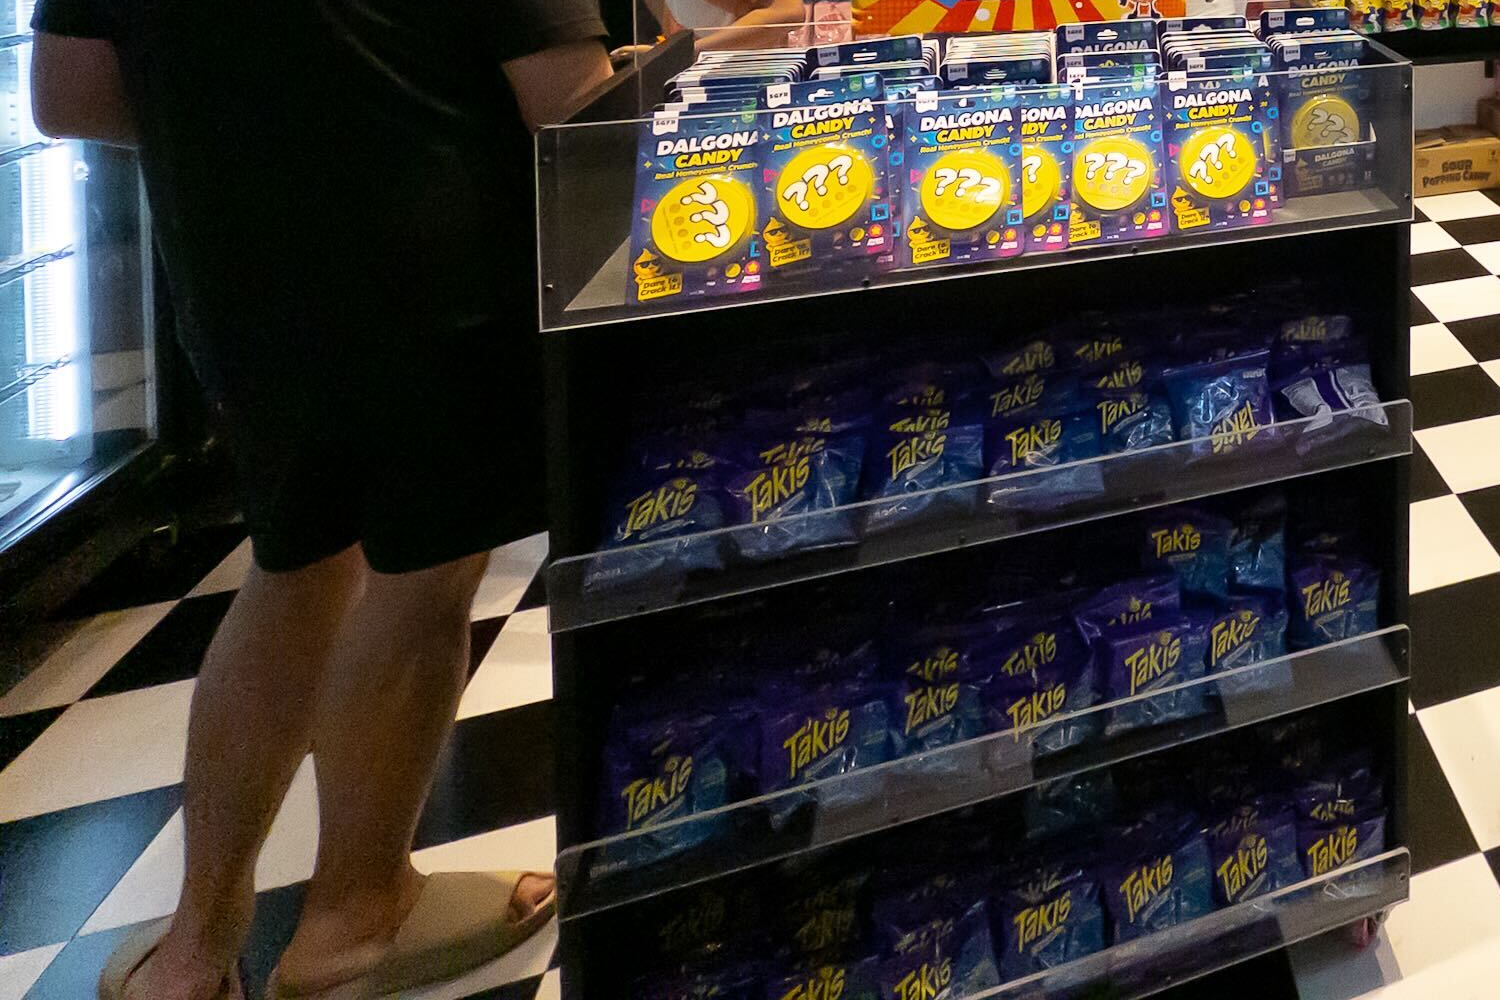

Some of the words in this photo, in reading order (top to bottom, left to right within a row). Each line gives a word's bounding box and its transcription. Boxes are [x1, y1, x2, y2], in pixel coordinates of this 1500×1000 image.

[1301, 73, 1346, 89] CANDY
[1174, 89, 1253, 109] DALGONA
[1188, 103, 1238, 120] CANDY
[773, 98, 874, 128] DALGONA
[920, 107, 1013, 131] DALGONA
[1083, 113, 1137, 130] CANDY
[791, 116, 855, 139] CANDY
[936, 125, 995, 142] CANDY
[656, 131, 758, 156] DALGONA
[675, 148, 744, 169] CANDY
[1004, 419, 1062, 466] Takis
[886, 433, 947, 482] Takis
[744, 456, 810, 523] Takis
[622, 479, 698, 541] Takis
[1152, 528, 1201, 559] Takis
[1125, 635, 1181, 696] Takis
[783, 708, 850, 780] Takis
[1120, 854, 1173, 923] Takis
